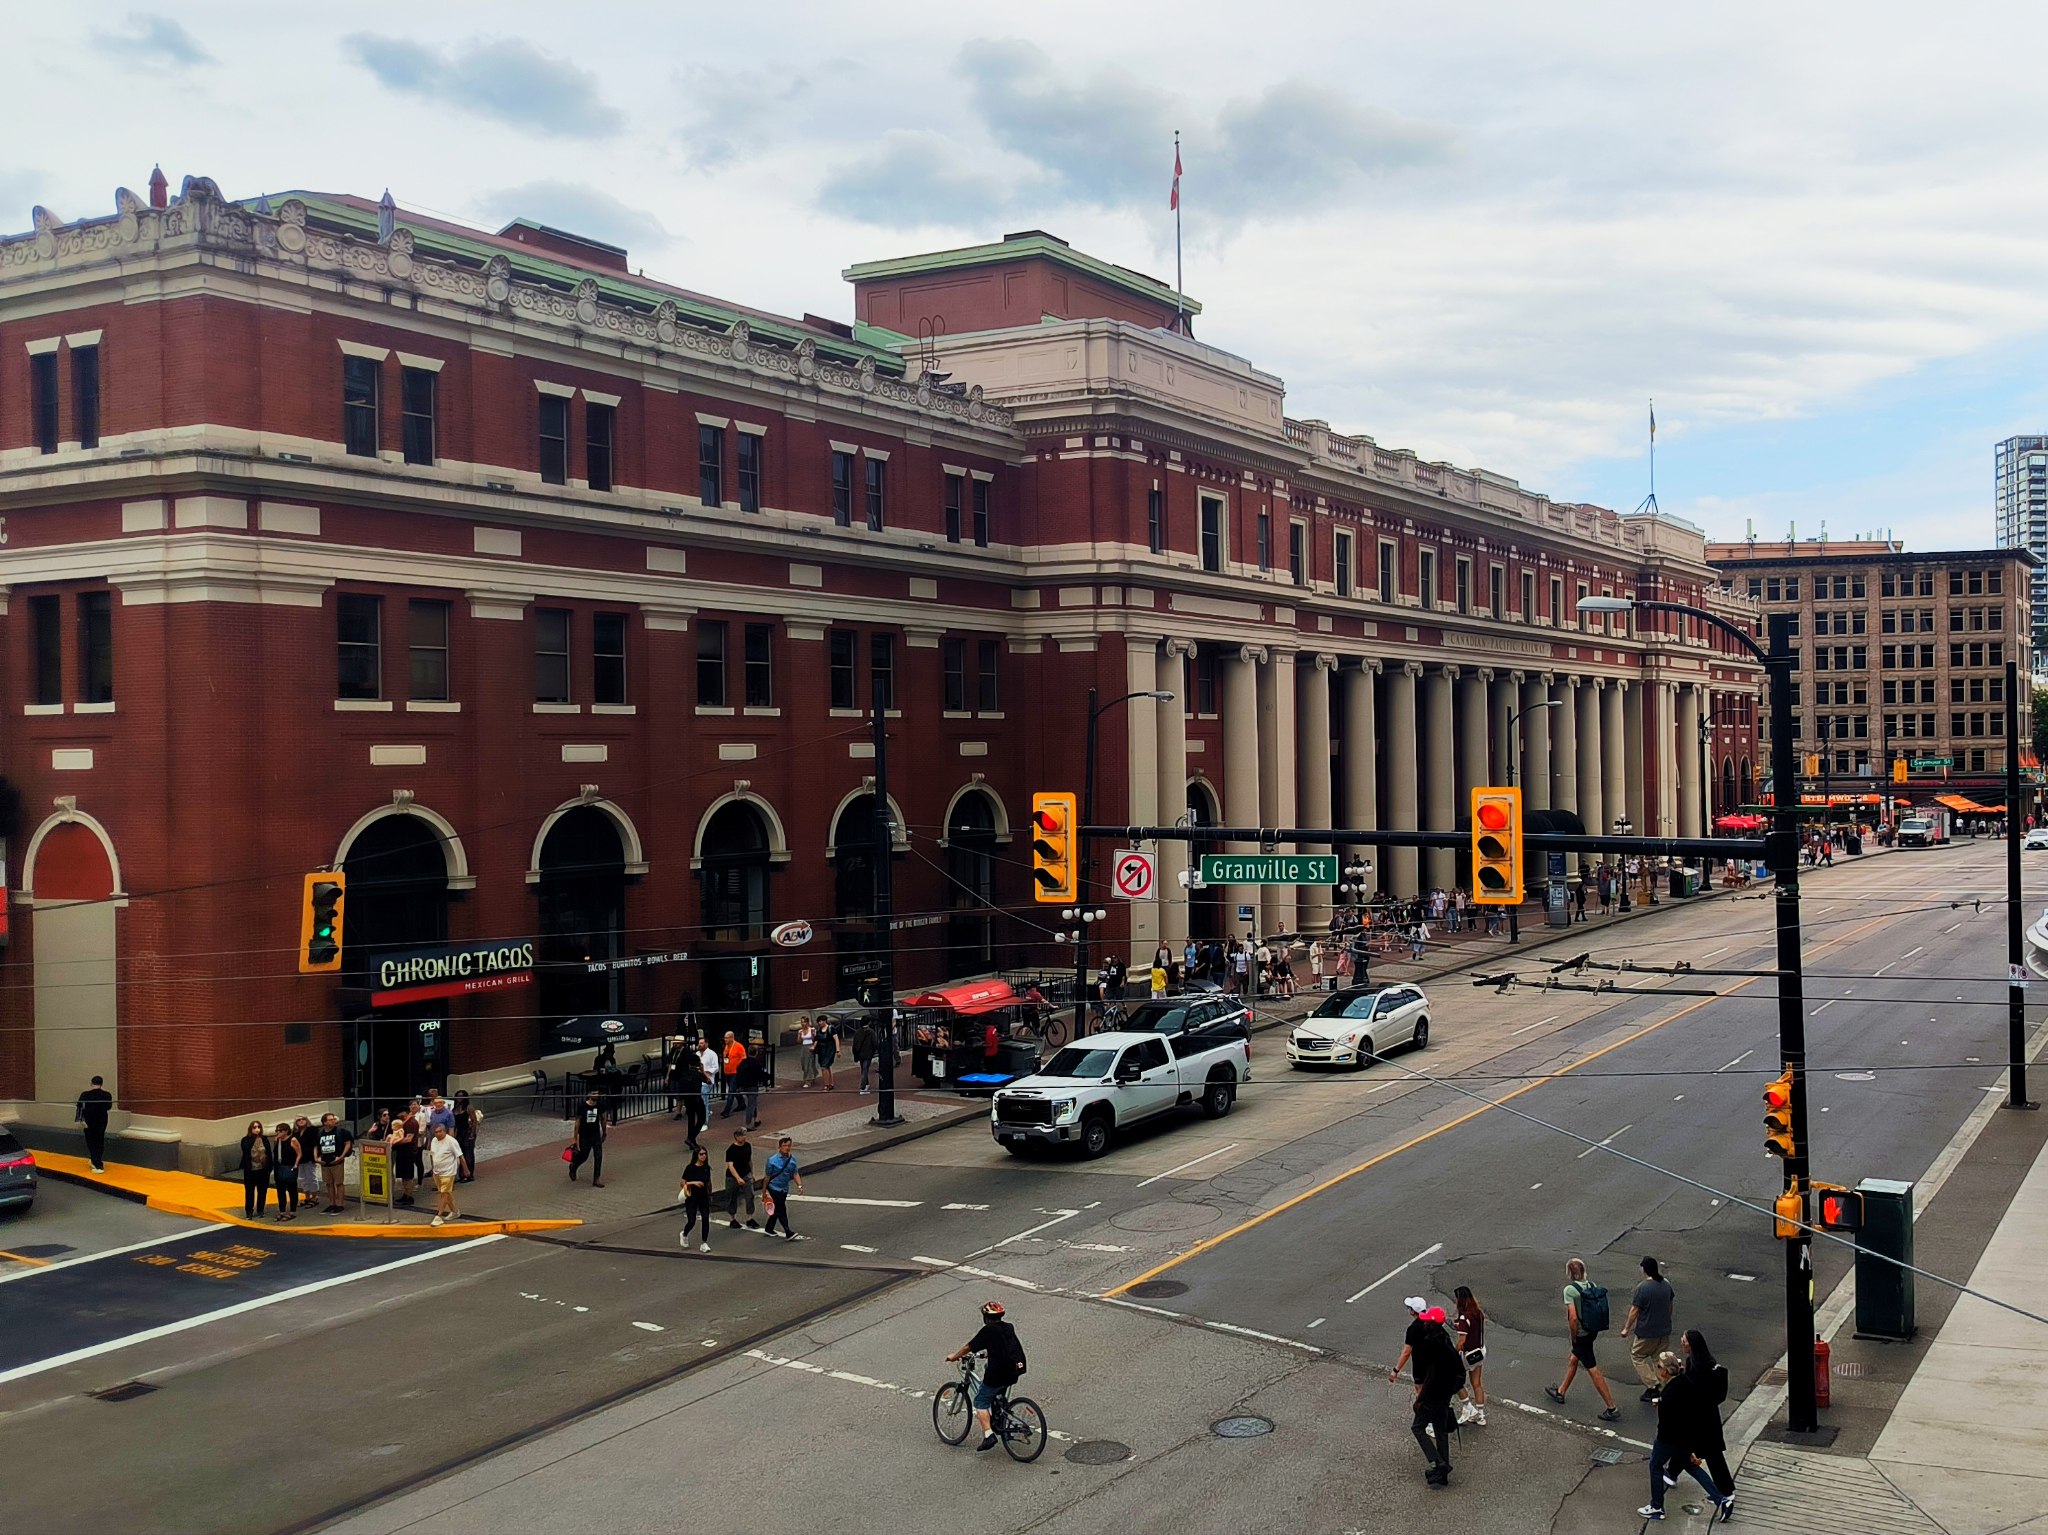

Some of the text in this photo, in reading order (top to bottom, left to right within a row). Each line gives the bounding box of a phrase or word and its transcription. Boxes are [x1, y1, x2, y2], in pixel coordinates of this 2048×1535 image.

[1450, 633, 1488, 648] CANADIAN
[1490, 638, 1519, 652] PACIFIC
[1212, 859, 1326, 879] Granville St
[782, 930, 811, 942] A&W
[381, 943, 533, 987] CHRONIC TACOS
[588, 952, 688, 972] TACOS BURRITOS BOWLS BEER
[465, 975, 530, 990] MEXICAN GRILL
[419, 1020, 441, 1032] OPEN
[364, 1145, 385, 1154] DANGER
